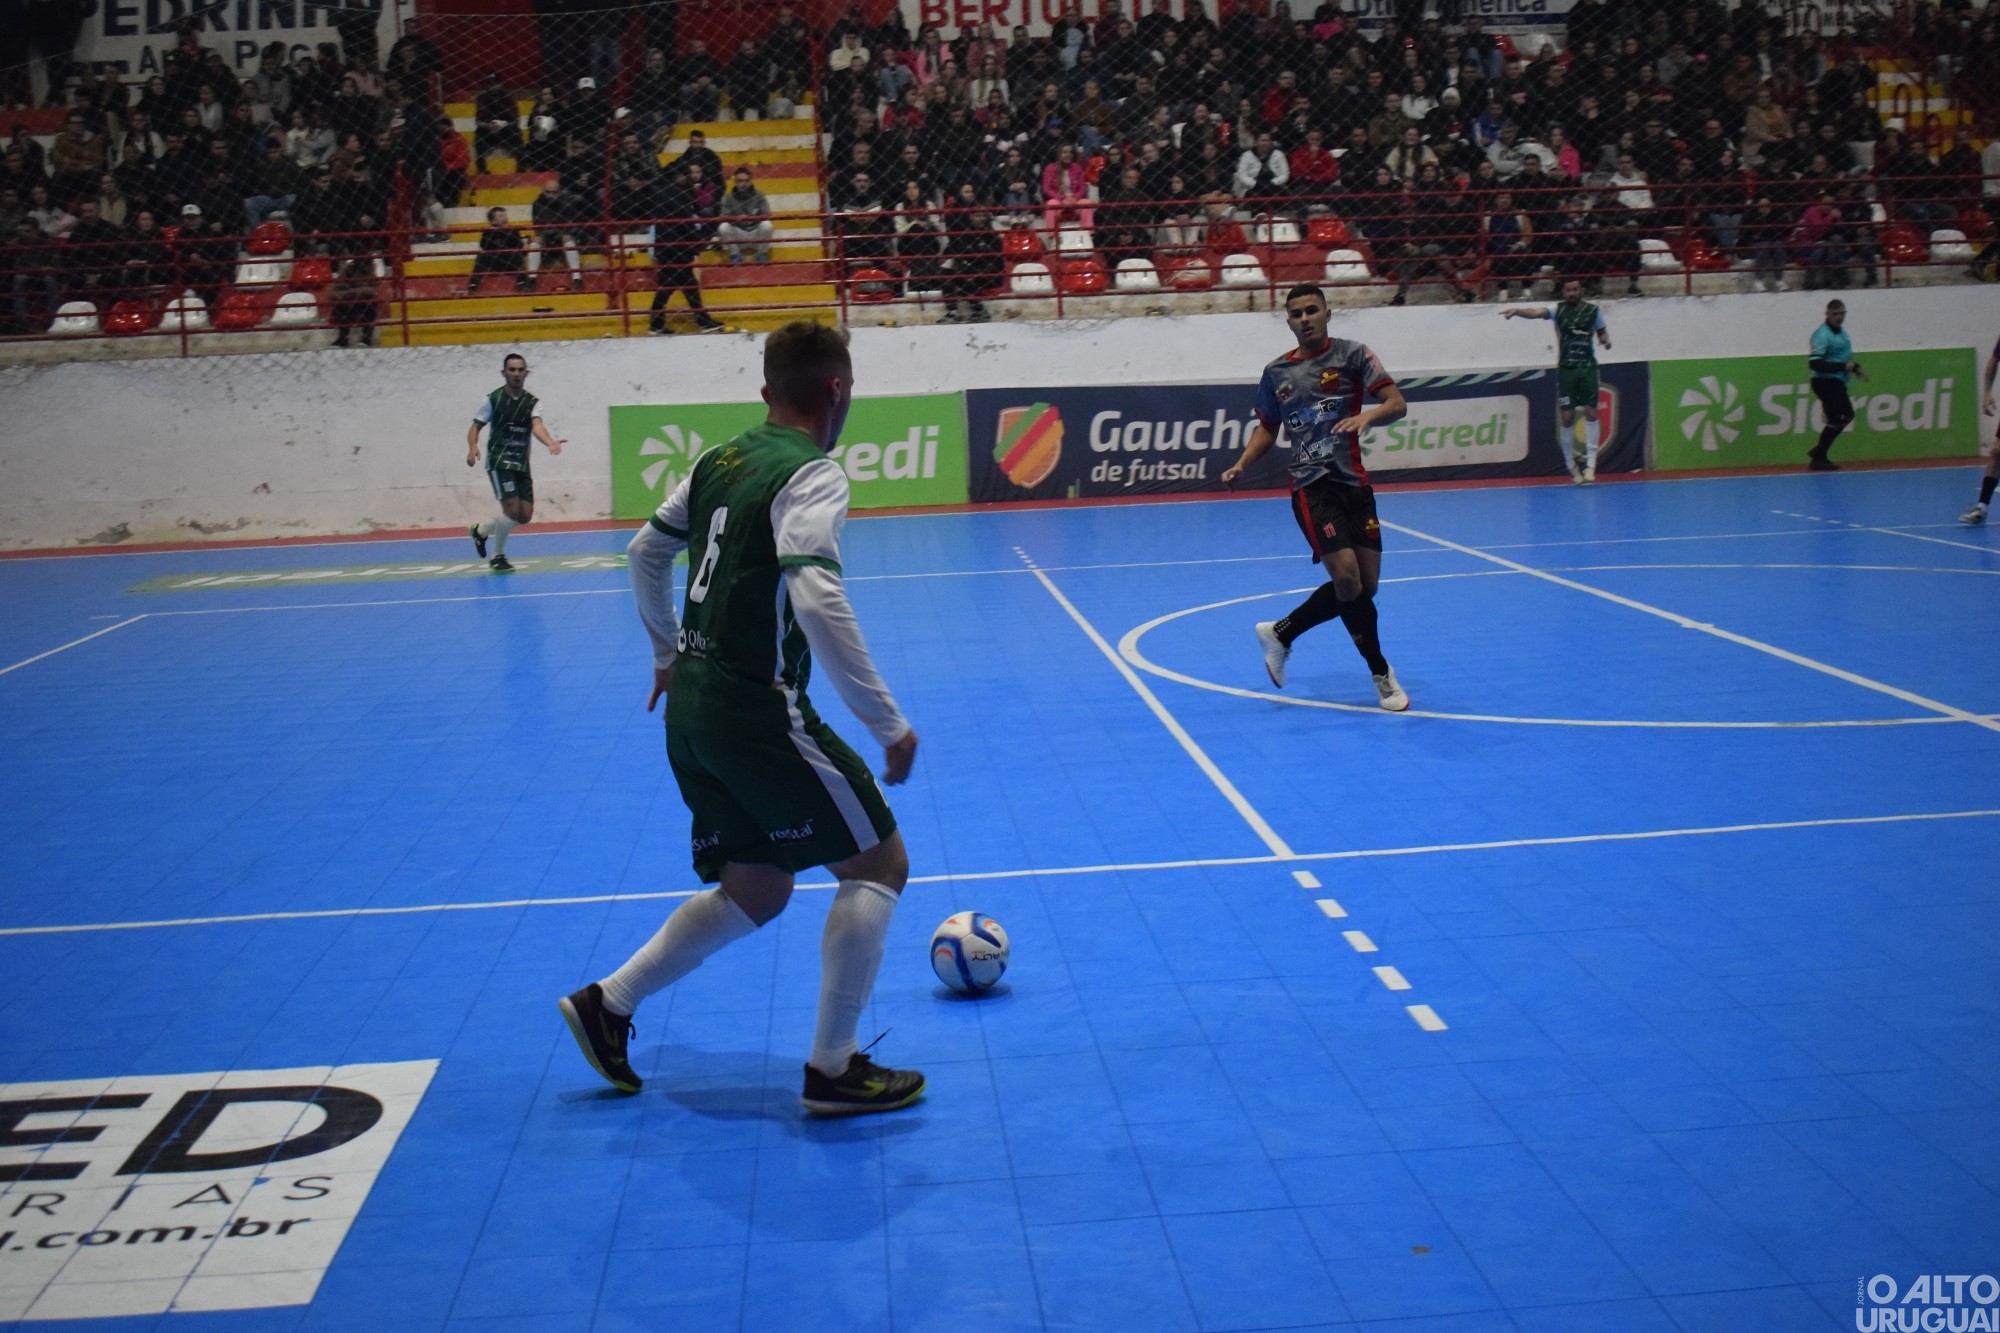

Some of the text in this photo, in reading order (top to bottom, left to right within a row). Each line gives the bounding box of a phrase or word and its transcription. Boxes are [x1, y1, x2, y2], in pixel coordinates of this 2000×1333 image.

[1384, 412, 1510, 452] Sicredi
[1091, 457, 1207, 487] de futsal
[689, 505, 728, 605] 6
